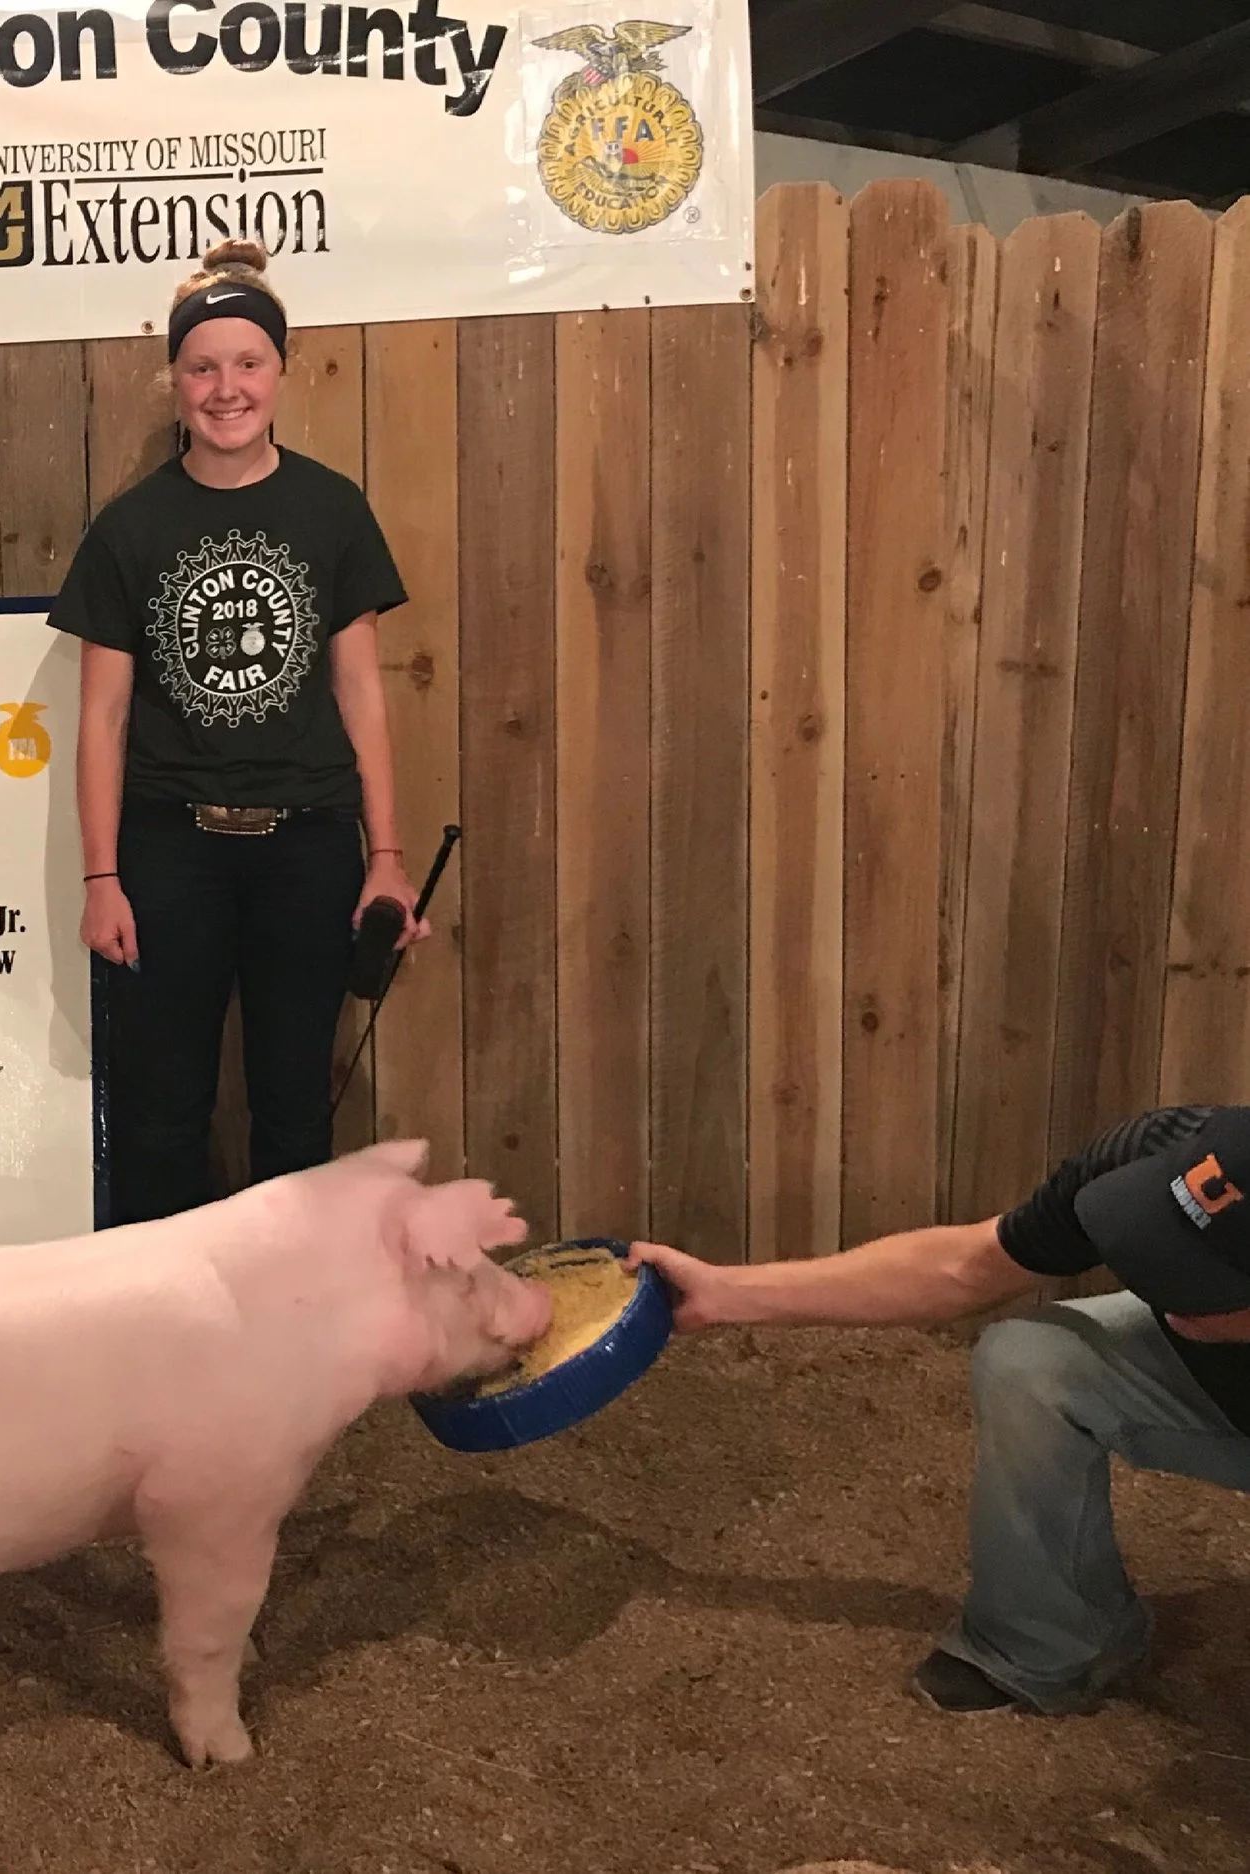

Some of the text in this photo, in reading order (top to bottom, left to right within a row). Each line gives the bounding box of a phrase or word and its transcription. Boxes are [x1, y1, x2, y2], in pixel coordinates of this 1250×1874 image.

[146, 0, 509, 117] County
[146, 137, 181, 171] OF
[190, 128, 326, 168] MISSOURI
[564, 94, 678, 156] AGRICULTURAL
[591, 115, 655, 142] FFA
[39, 168, 330, 266] Extension
[181, 568, 293, 659] CLINTON COUNTY
[212, 599, 258, 621] 2018
[203, 663, 267, 691] FAIR
